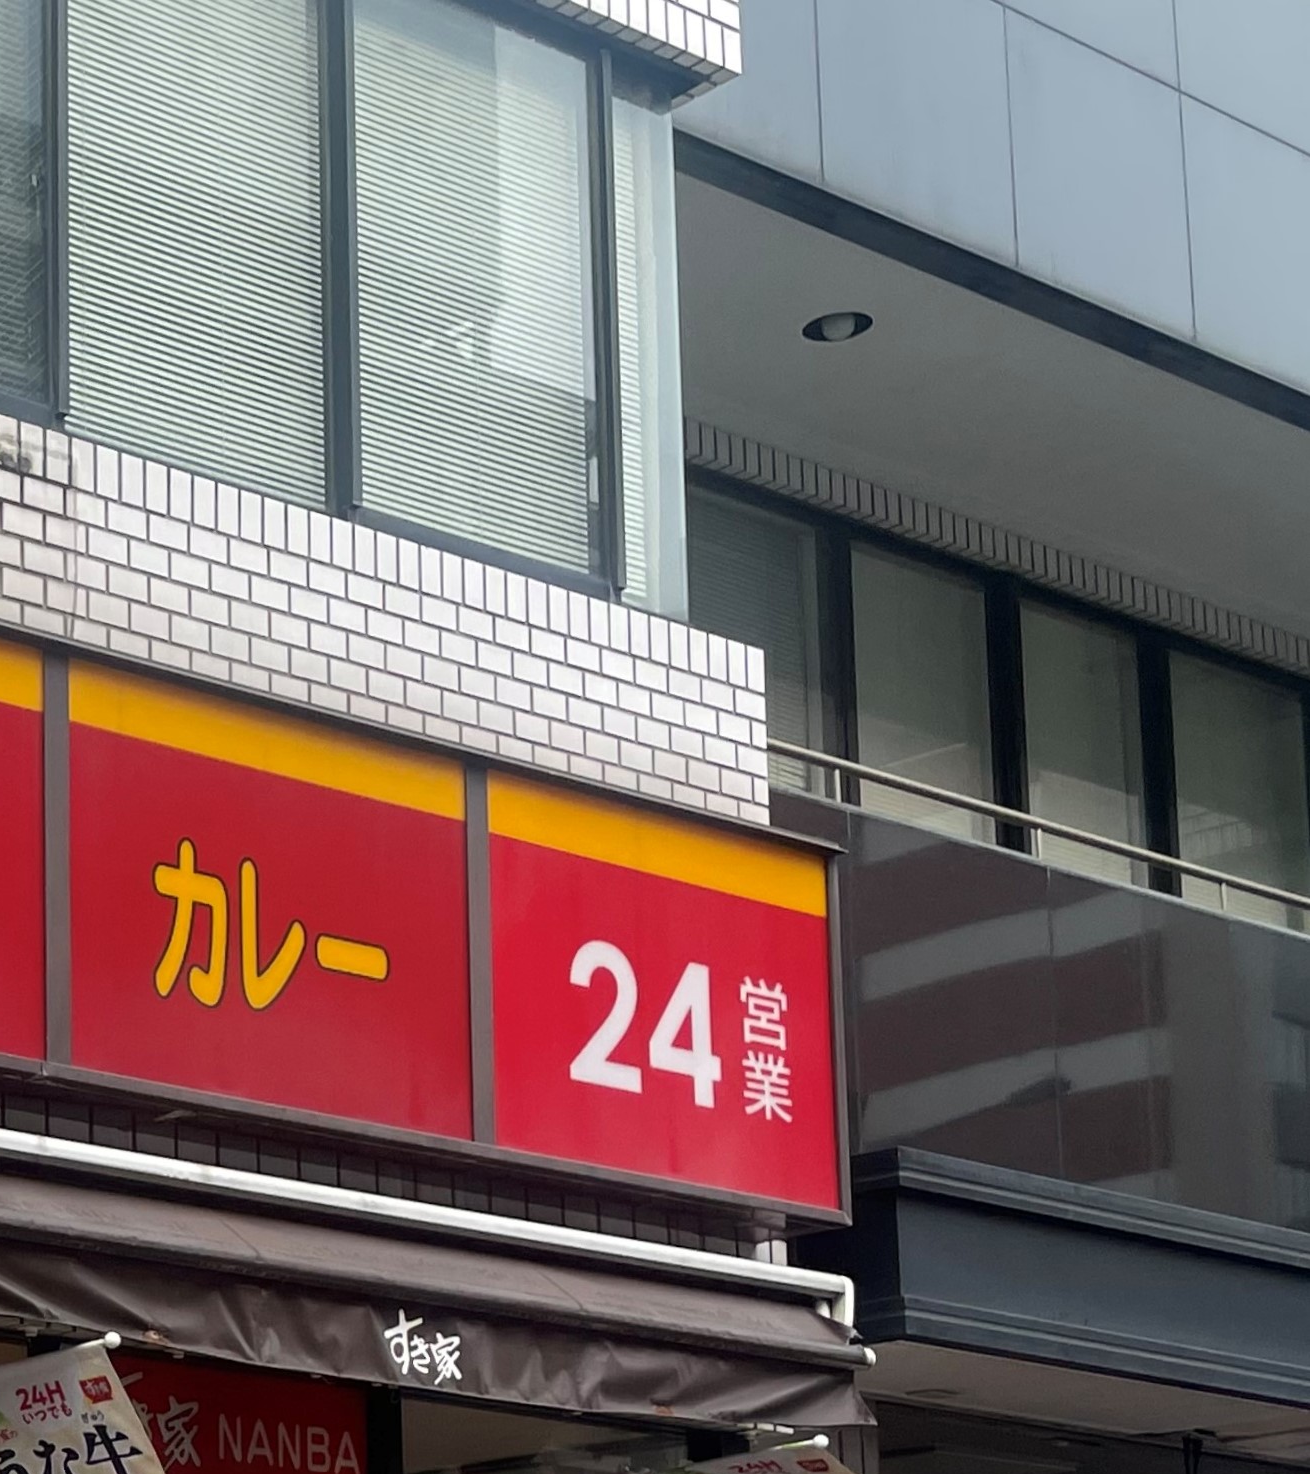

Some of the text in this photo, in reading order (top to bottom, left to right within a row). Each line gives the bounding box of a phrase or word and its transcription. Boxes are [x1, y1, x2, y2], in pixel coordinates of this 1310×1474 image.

[153, 837, 389, 1010] カレー
[569, 939, 794, 1124] 24 営業
[384, 1308, 463, 1386] すき家
[16, 1380, 66, 1411] 24H
[22, 1402, 72, 1425] いつでも
